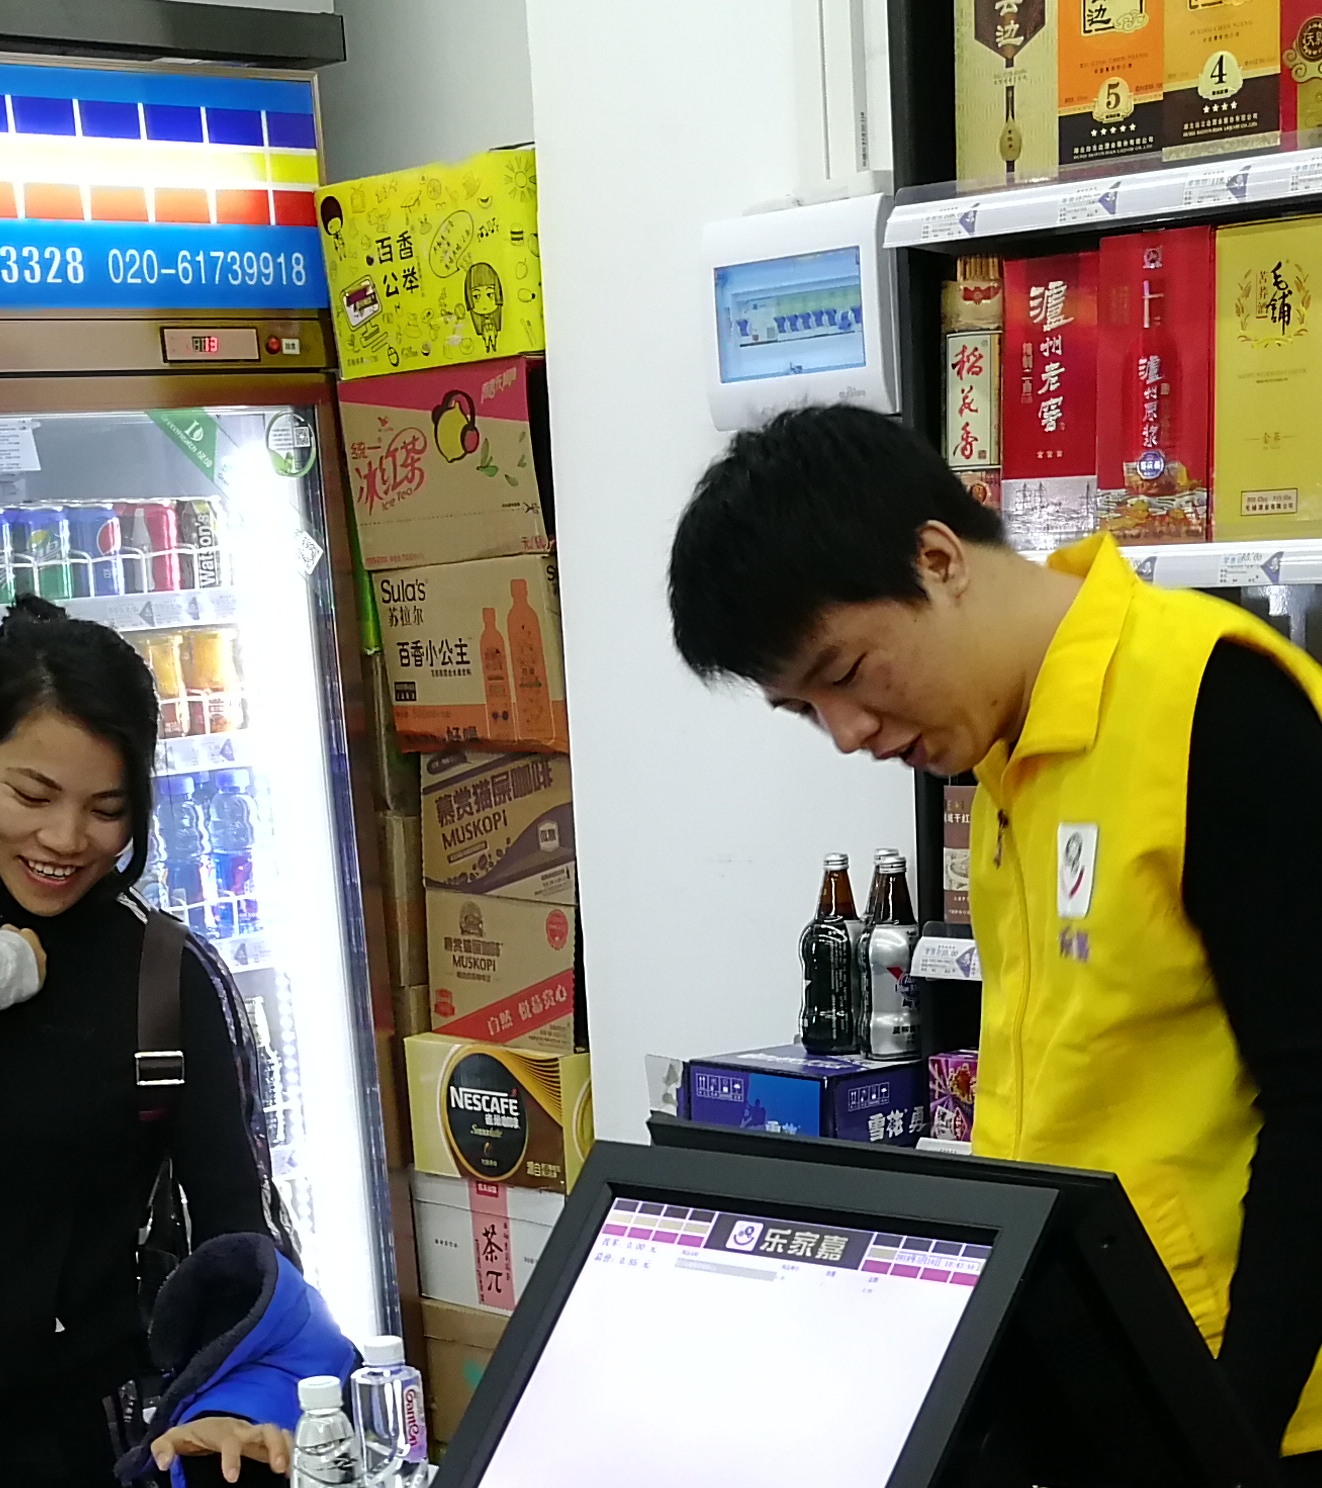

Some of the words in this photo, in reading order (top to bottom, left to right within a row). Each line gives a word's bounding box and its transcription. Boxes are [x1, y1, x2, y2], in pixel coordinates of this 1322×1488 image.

[1209, 53, 1226, 85] 4
[1105, 82, 1121, 110] 5
[108, 248, 306, 288] 020-61739918
[380, 577, 426, 604] Sula's
[759, 1228, 849, 1262] 乐家嘉
